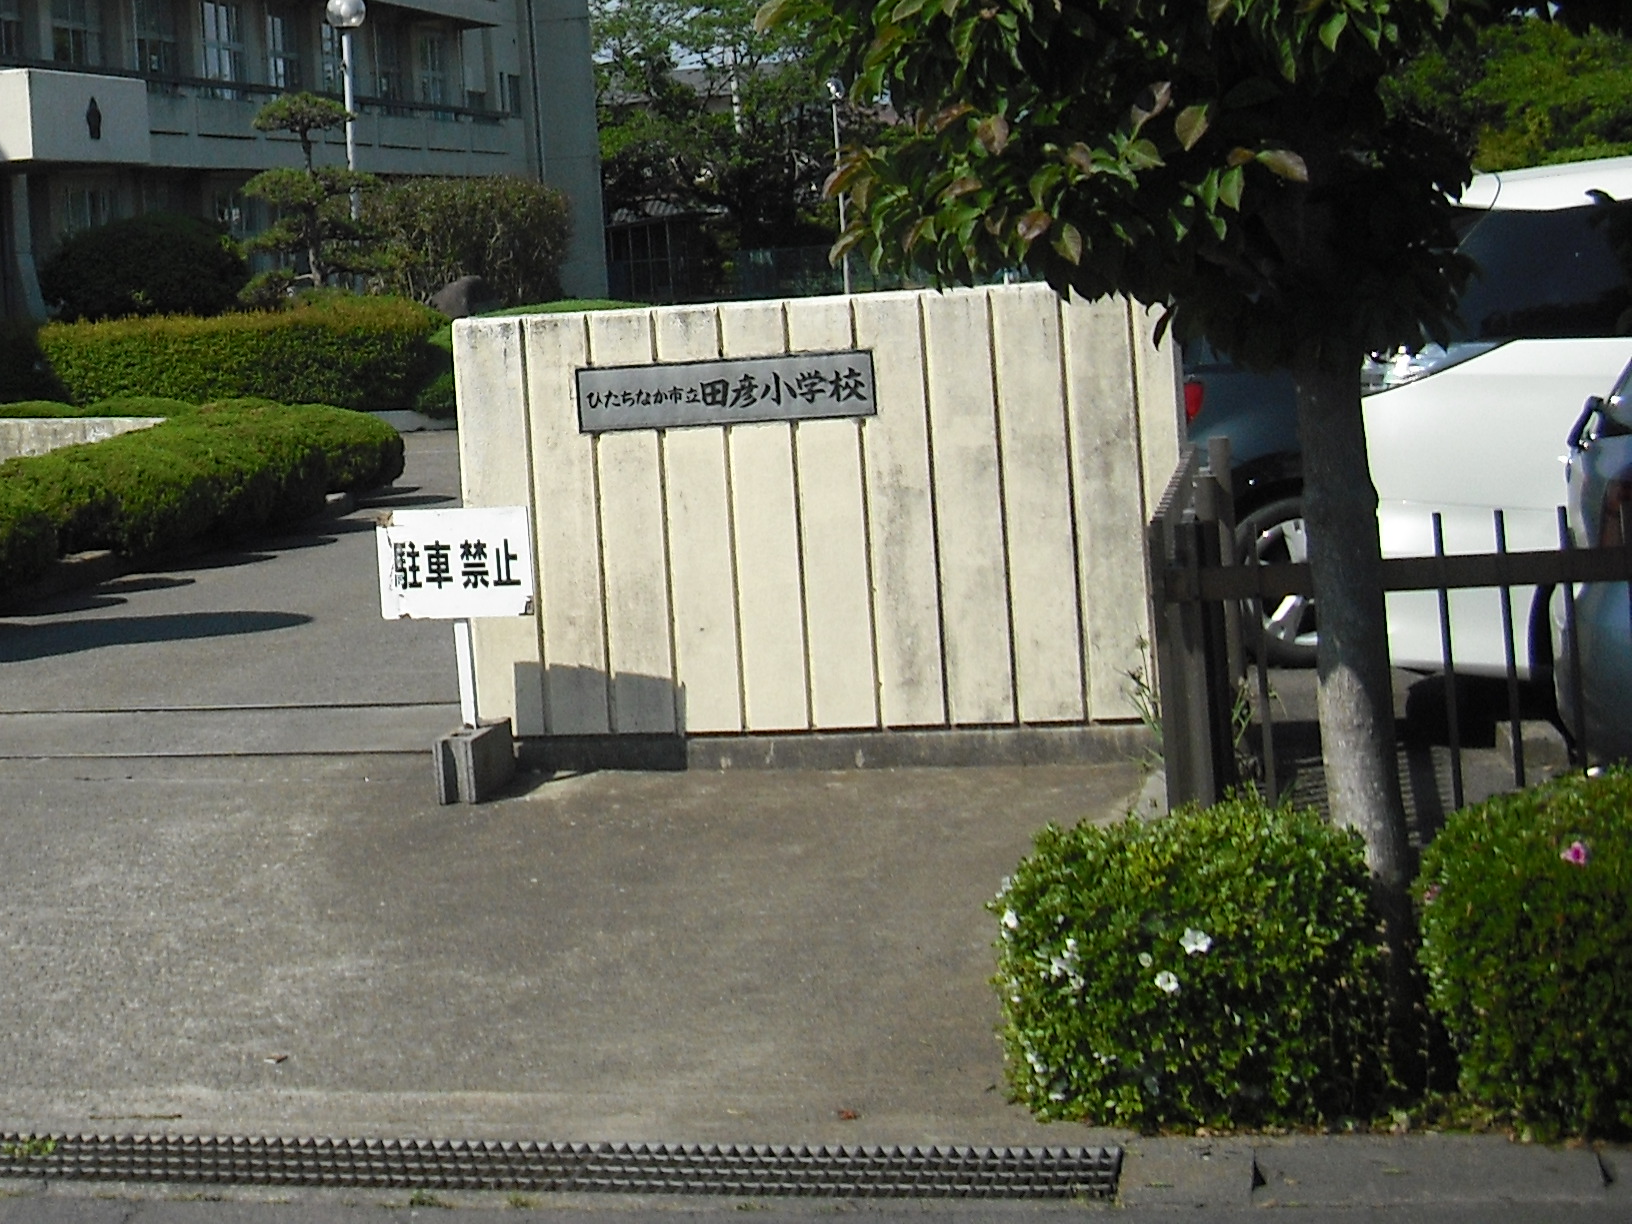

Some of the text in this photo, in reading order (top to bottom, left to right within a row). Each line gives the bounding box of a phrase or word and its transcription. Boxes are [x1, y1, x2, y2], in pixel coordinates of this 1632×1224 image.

[585, 367, 868, 409] ひたちなか市立田彦小学校
[393, 539, 521, 590] 駐車禁止
